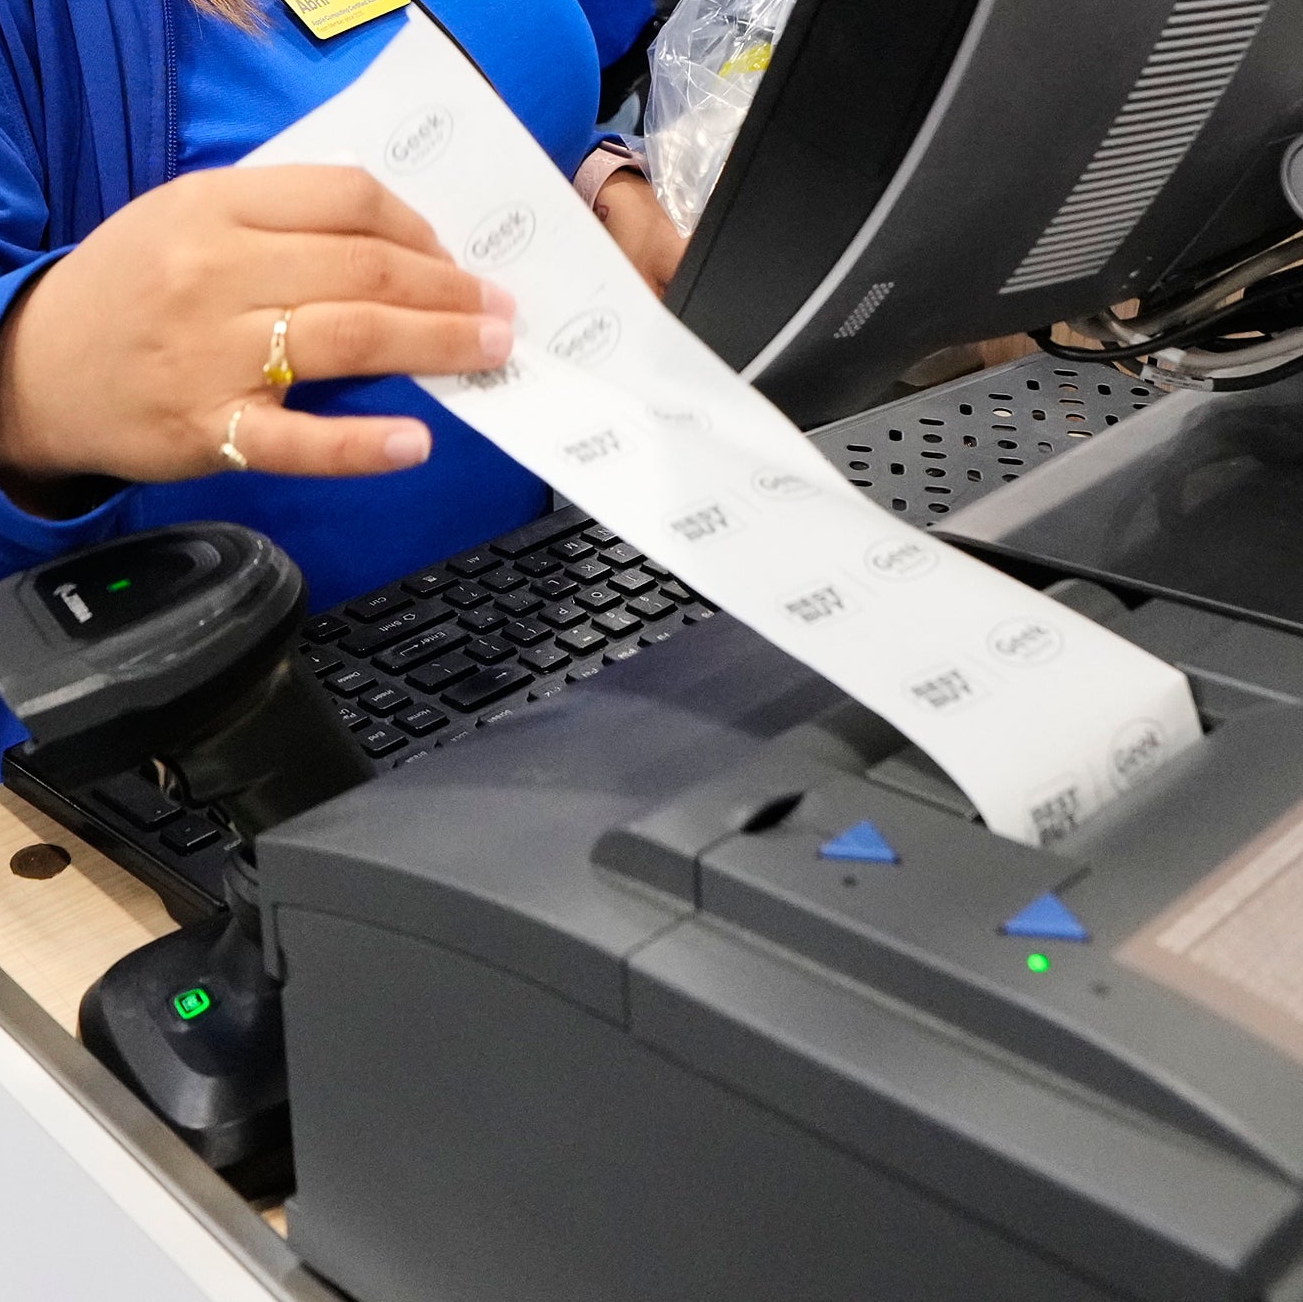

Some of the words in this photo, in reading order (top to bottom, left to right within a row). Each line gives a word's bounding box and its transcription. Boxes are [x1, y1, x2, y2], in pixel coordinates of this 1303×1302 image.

[369, 596, 387, 607] Ctrl
[378, 620, 403, 632] Shift
[420, 631, 447, 646] Enter
[337, 671, 361, 684] Delete
[371, 689, 395, 702] Insert
[406, 708, 432, 722] Home
[367, 731, 386, 742] End
